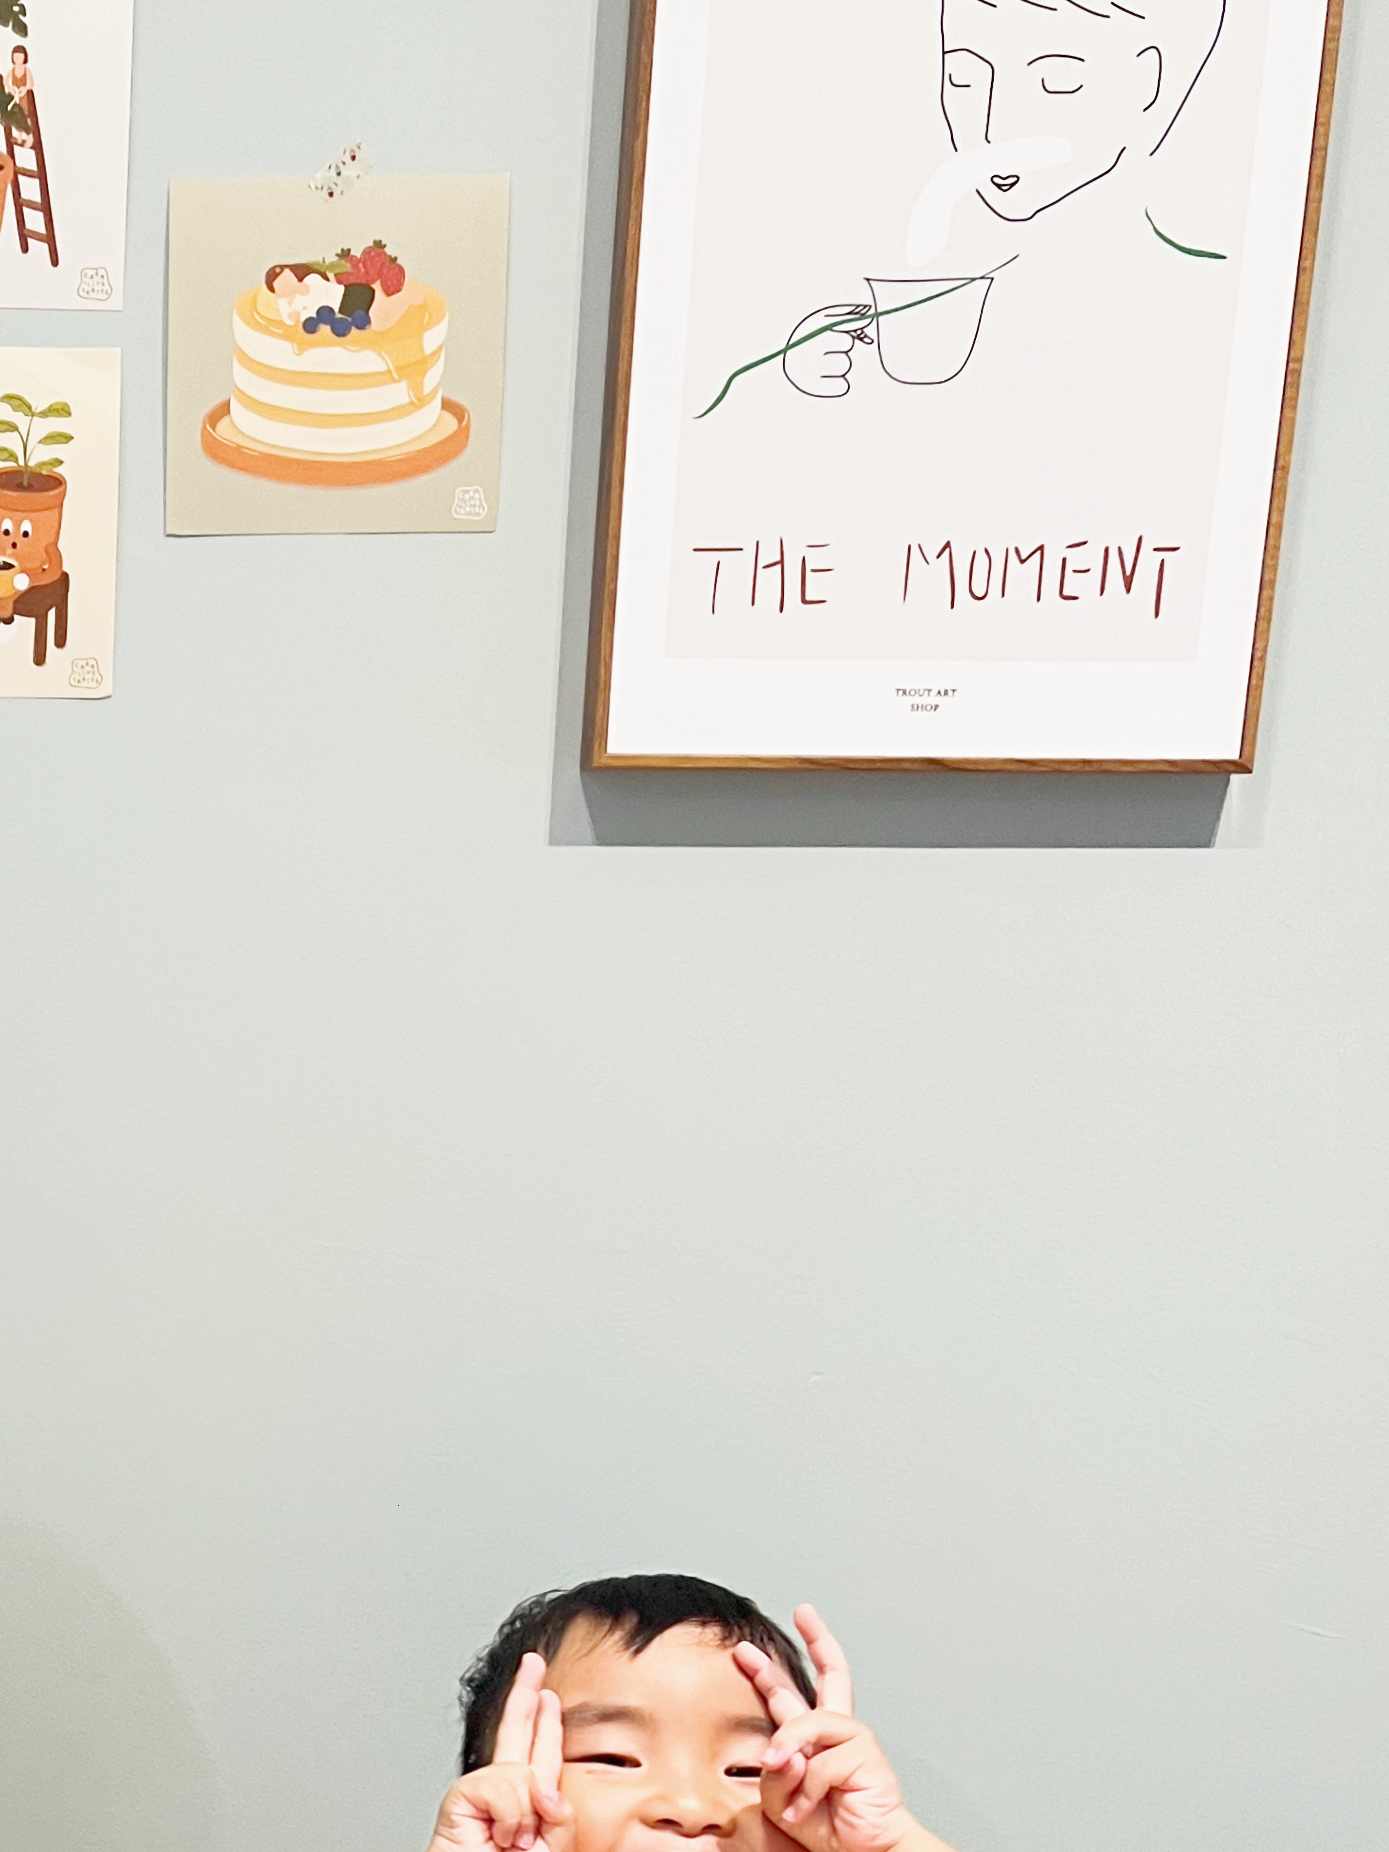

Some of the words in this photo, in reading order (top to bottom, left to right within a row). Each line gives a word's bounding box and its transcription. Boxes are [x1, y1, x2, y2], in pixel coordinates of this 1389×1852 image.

[692, 536, 835, 615] THE
[902, 534, 1181, 620] MOMENT
[894, 688, 933, 697] TROUT
[910, 703, 939, 712] SHOP
